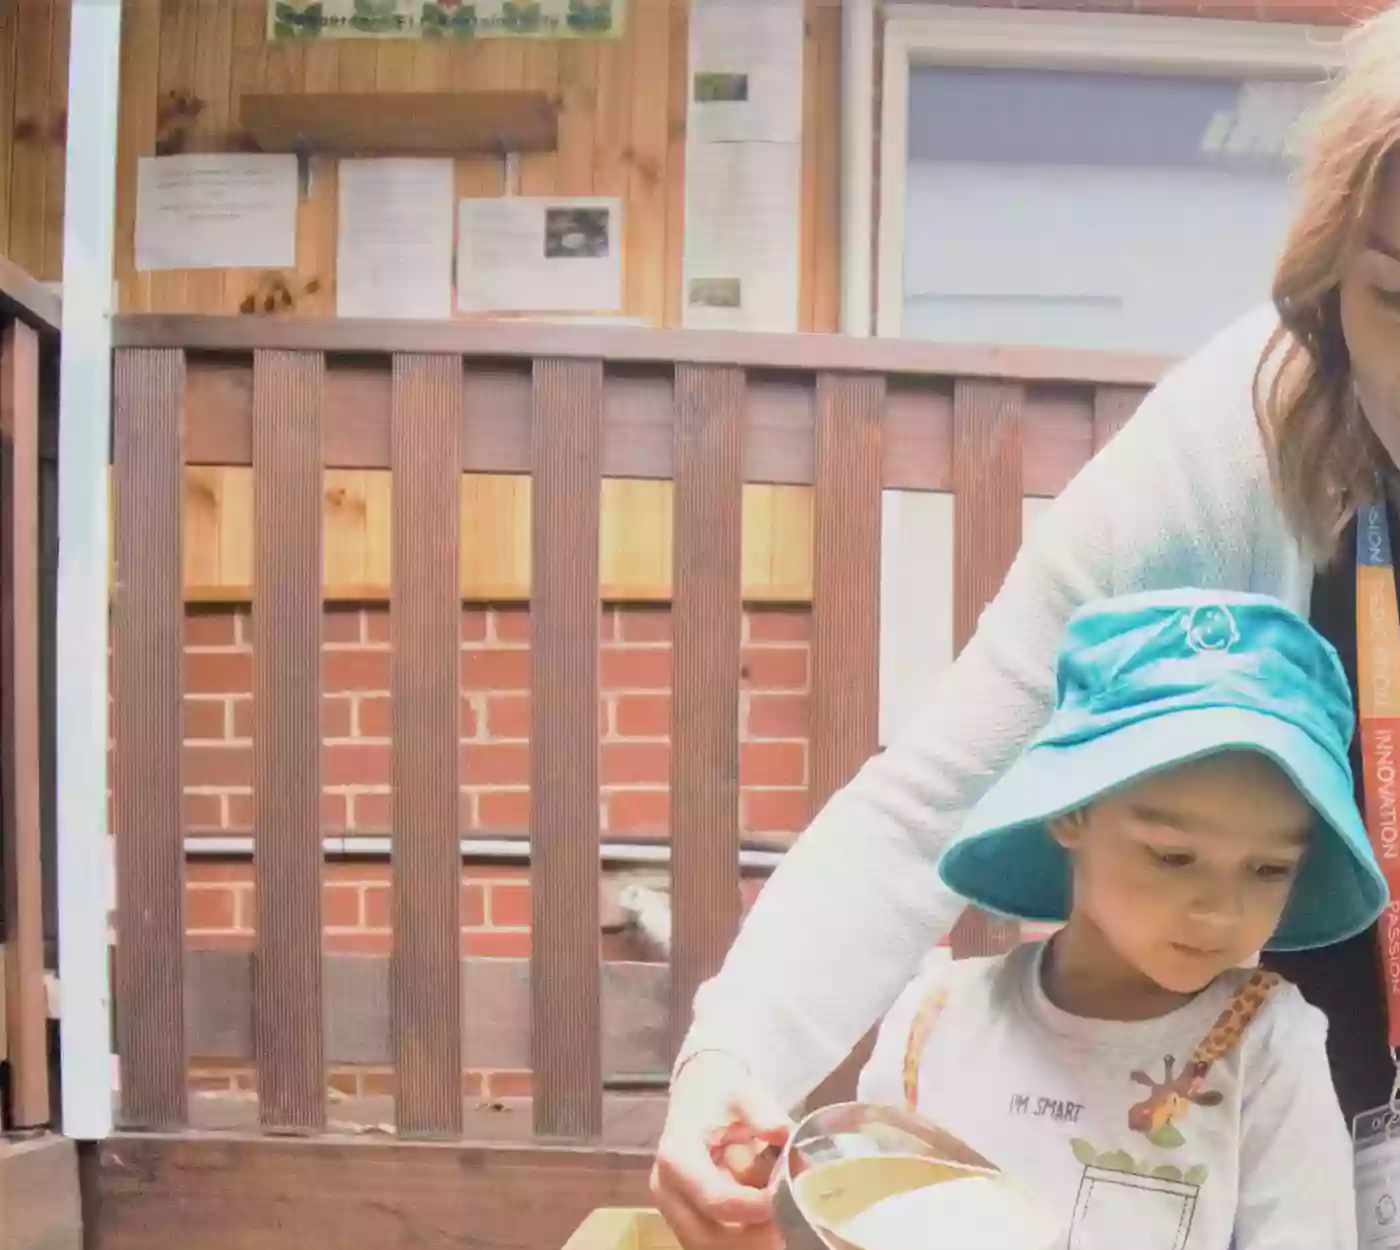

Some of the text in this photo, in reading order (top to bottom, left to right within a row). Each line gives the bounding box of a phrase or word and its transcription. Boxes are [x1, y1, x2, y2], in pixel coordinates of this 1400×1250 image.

[1366, 506, 1385, 564] SION
[1372, 728, 1400, 859] INNOVATION
[1033, 1097, 1086, 1124] SMART
